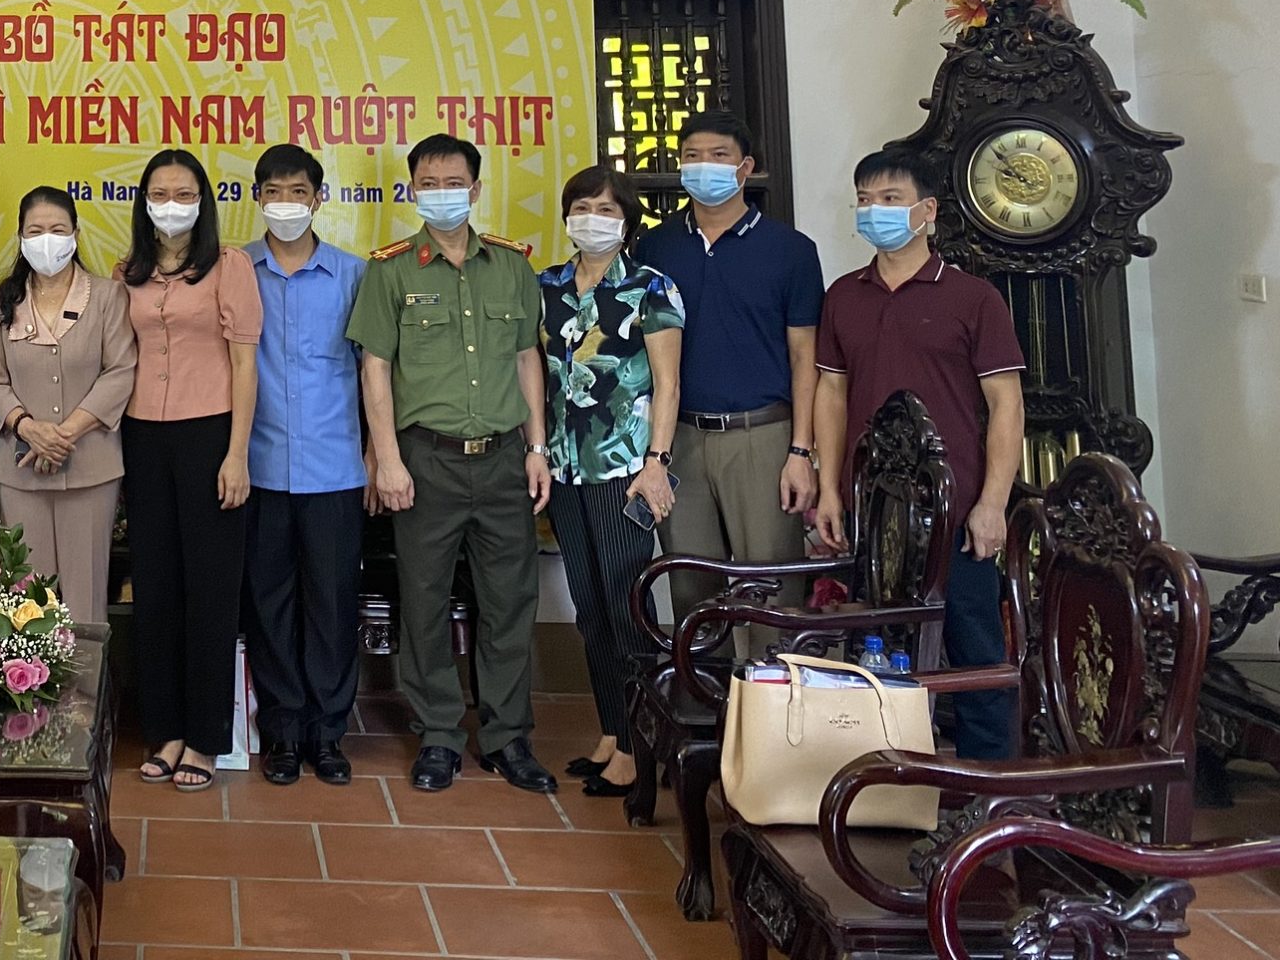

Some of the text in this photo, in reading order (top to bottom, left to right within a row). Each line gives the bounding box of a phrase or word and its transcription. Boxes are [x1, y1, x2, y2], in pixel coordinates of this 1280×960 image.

[73, 0, 166, 63] TÁT
[184, 13, 287, 72] ĐẠO
[27, 78, 140, 145] MIỀN
[160, 94, 266, 145] NAM
[287, 83, 416, 156] RUỘT
[436, 95, 553, 157] THỊT
[67, 181, 93, 201] Hà
[217, 181, 242, 202] 29
[341, 183, 383, 203] năm
[393, 182, 415, 203] 20
